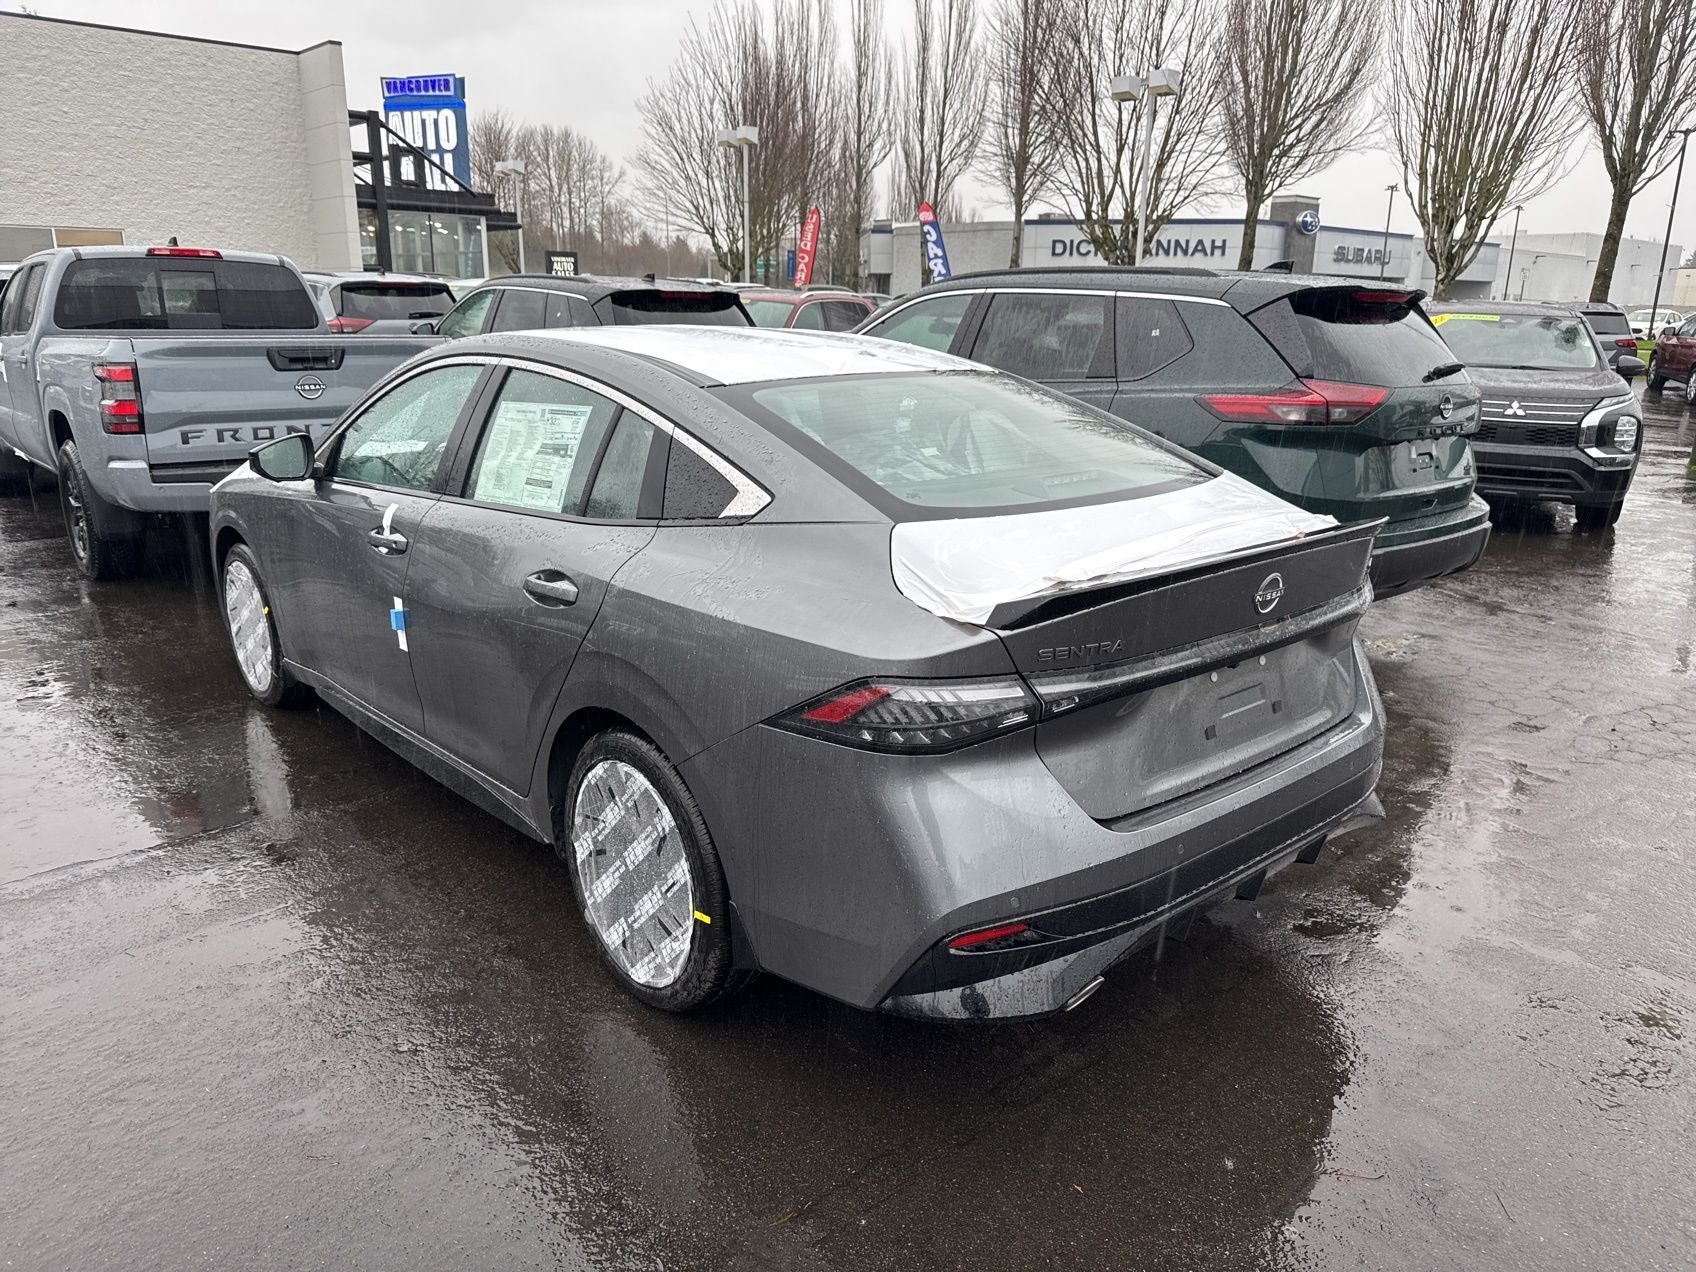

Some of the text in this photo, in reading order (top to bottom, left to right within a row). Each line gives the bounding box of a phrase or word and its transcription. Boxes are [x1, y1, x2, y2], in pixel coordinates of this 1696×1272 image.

[385, 78, 452, 94] VANCOUVER
[387, 108, 458, 151] AUTO
[1051, 239, 1099, 257] DIC
[1333, 245, 1392, 265] SUBARU
[552, 262, 574, 271] AUTO
[179, 424, 334, 446] FRON
[1255, 589, 1285, 603] NISSAN
[1037, 639, 1125, 661] SENTRA
